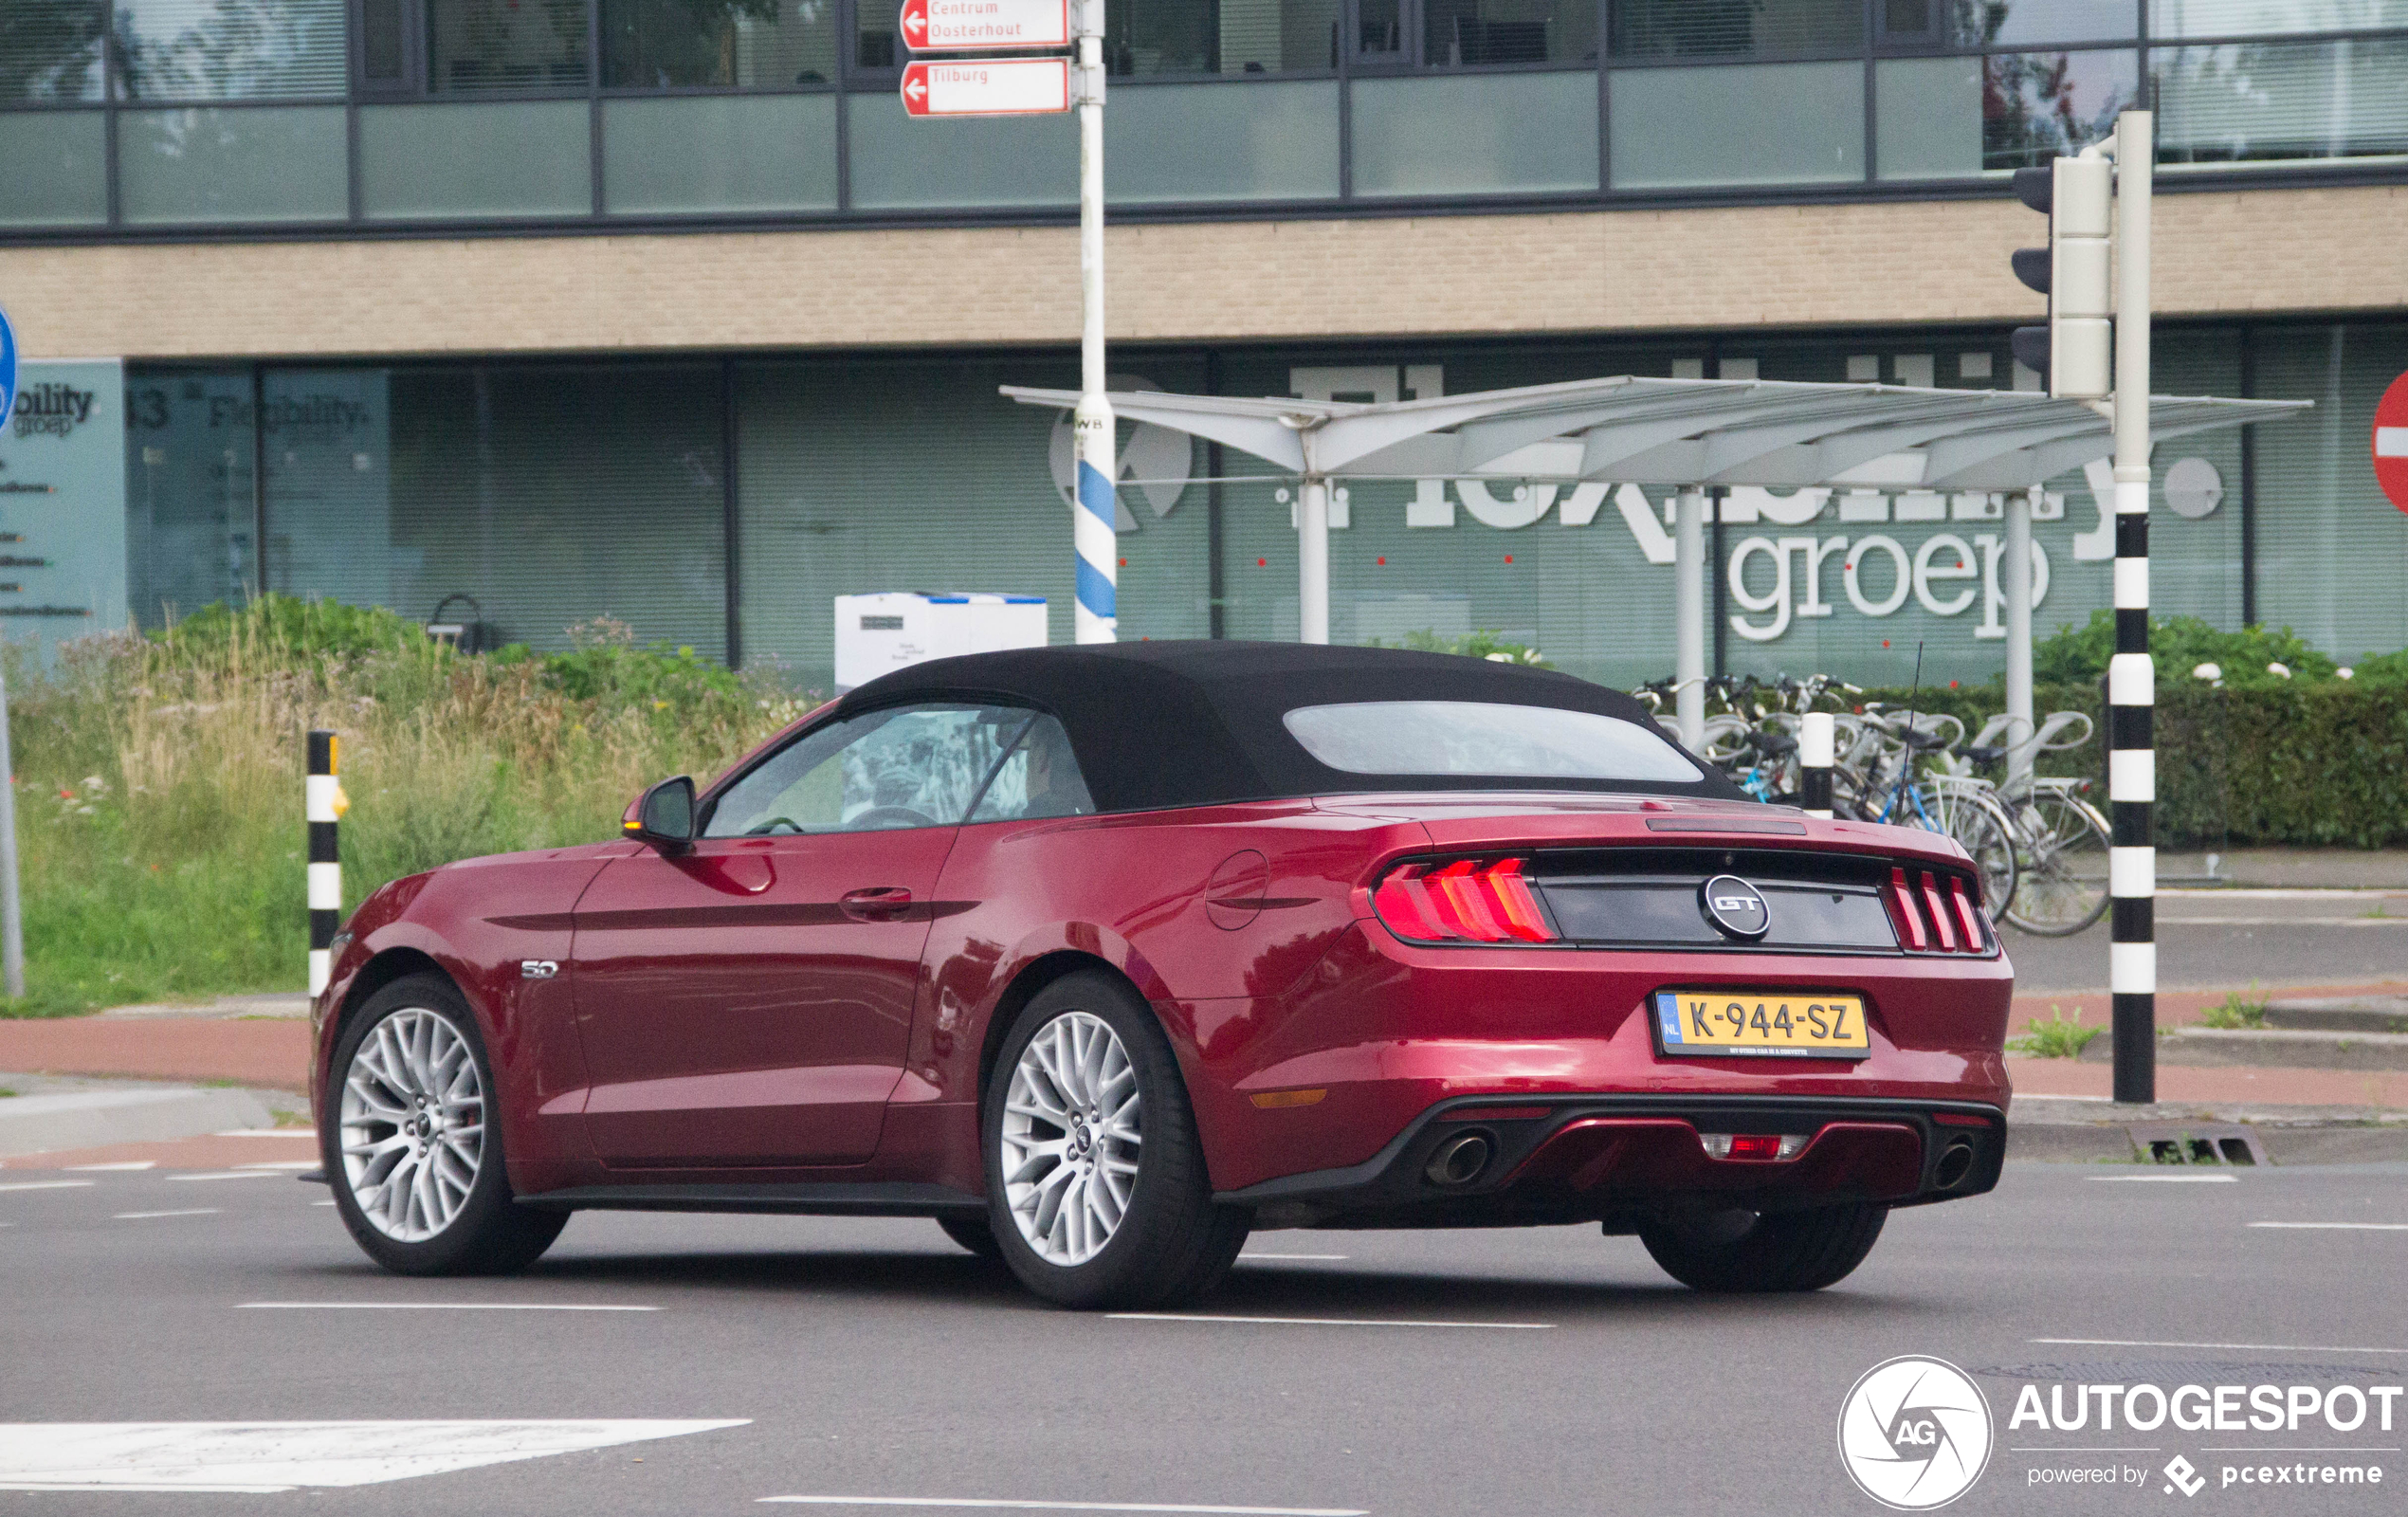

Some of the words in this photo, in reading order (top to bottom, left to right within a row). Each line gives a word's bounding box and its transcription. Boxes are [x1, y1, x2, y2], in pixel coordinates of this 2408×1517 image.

[930, 2, 998, 15] Centrum
[931, 23, 1021, 37] Oosterhout
[932, 68, 988, 84] Tilburg
[1728, 533, 2050, 641] groep
[1714, 896, 1760, 911] GT
[1689, 1001, 1852, 1039] K-944-SZ
[1665, 1024, 1679, 1035] NL
